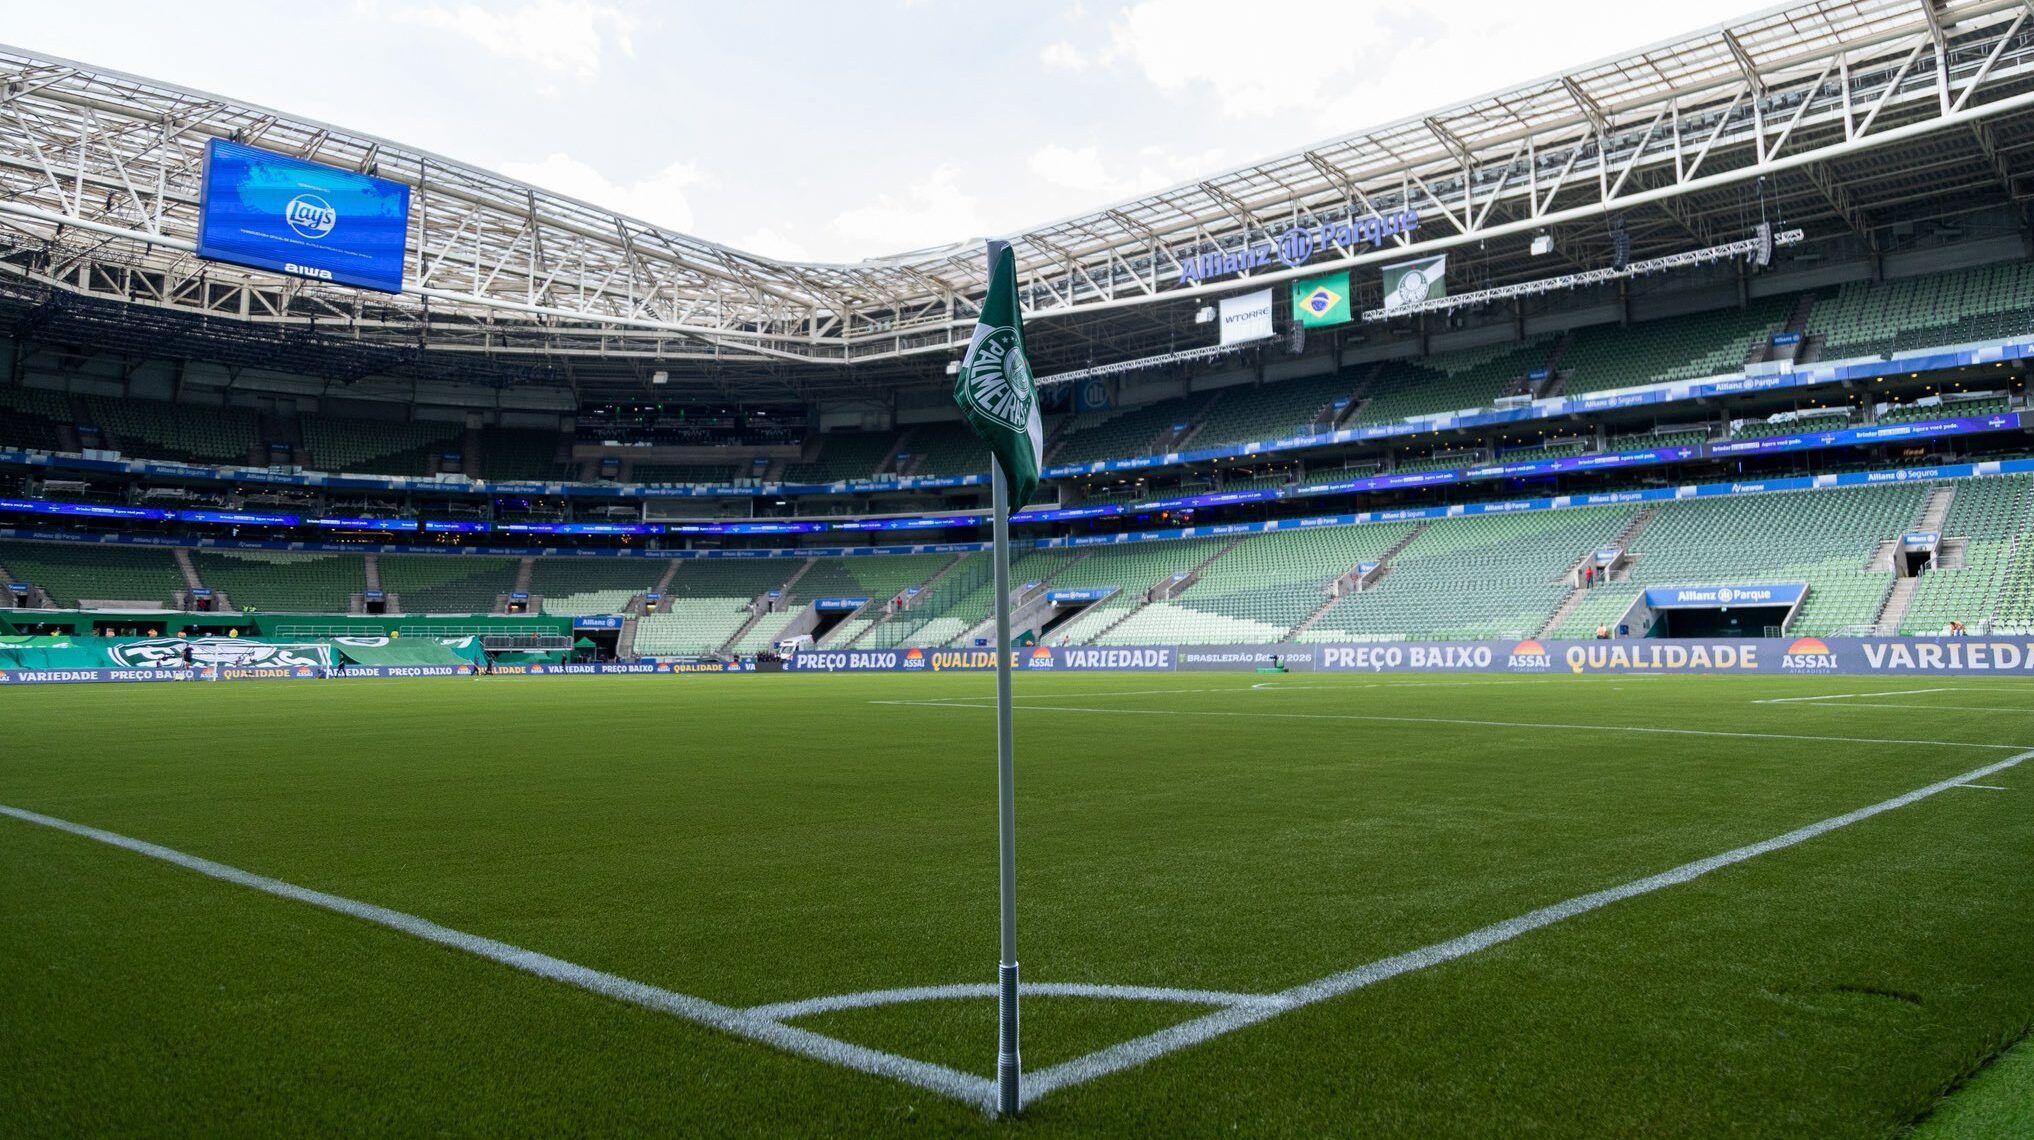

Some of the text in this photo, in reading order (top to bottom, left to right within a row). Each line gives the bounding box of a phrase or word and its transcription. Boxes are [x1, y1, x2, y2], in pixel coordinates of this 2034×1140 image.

[1179, 208, 1419, 284] Allianz Parque
[284, 262, 333, 280] aiwa
[1224, 306, 1271, 325] WTORRE
[970, 338, 1027, 427] PALMEIRAS
[1715, 377, 1780, 392] Allianz Parque
[1584, 399, 1608, 409] Allianz
[1868, 469, 1938, 481] Allianz Seguros
[1588, 492, 1642, 503] Allianz Seguros
[1484, 503, 1504, 512] Allianz
[1382, 511, 1400, 519] Allianz
[1678, 589, 1771, 602] Allianz Parque
[797, 652, 897, 671] PREÇO BAIXO
[931, 652, 1020, 671] QUALIDAE
[1065, 650, 1169, 668] VARIEDADE
[1187, 653, 1253, 662] BRASILEIRÃO
[1287, 653, 1312, 662] 2026
[1324, 646, 1492, 672] PREÇO BAIXO
[1566, 645, 1758, 673] QUALIDADE
[388, 667, 421, 677] PREÇO
[422, 667, 453, 675] BAIXO
[602, 665, 626, 674] PREÇO
[628, 664, 654, 673] BAIXO
[673, 664, 723, 674] QUALIDADE
[18, 671, 99, 682] VARIEDADE
[110, 670, 152, 681] PREÇO
